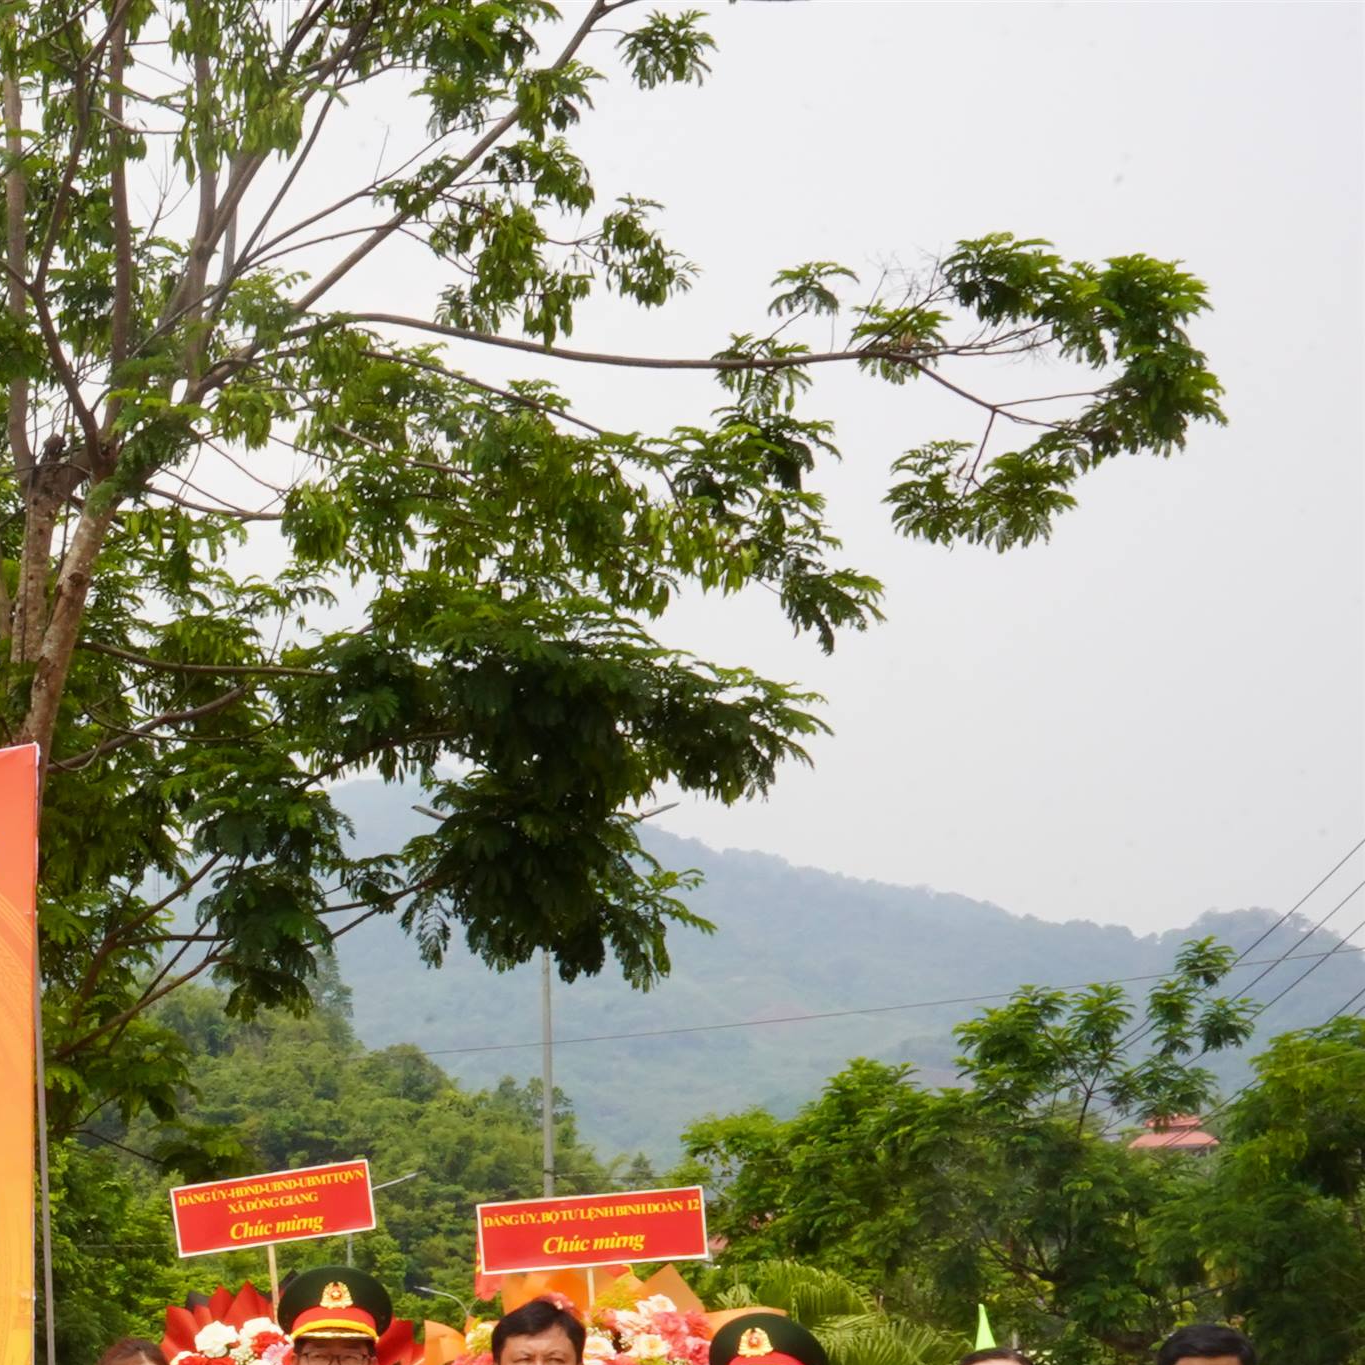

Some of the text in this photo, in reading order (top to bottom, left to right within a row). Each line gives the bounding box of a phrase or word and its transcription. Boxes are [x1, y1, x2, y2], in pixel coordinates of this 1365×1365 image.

[688, 1199, 700, 1211] 12
[229, 1214, 324, 1241] Chúc mừng
[543, 1231, 645, 1254] Chúc mừng
